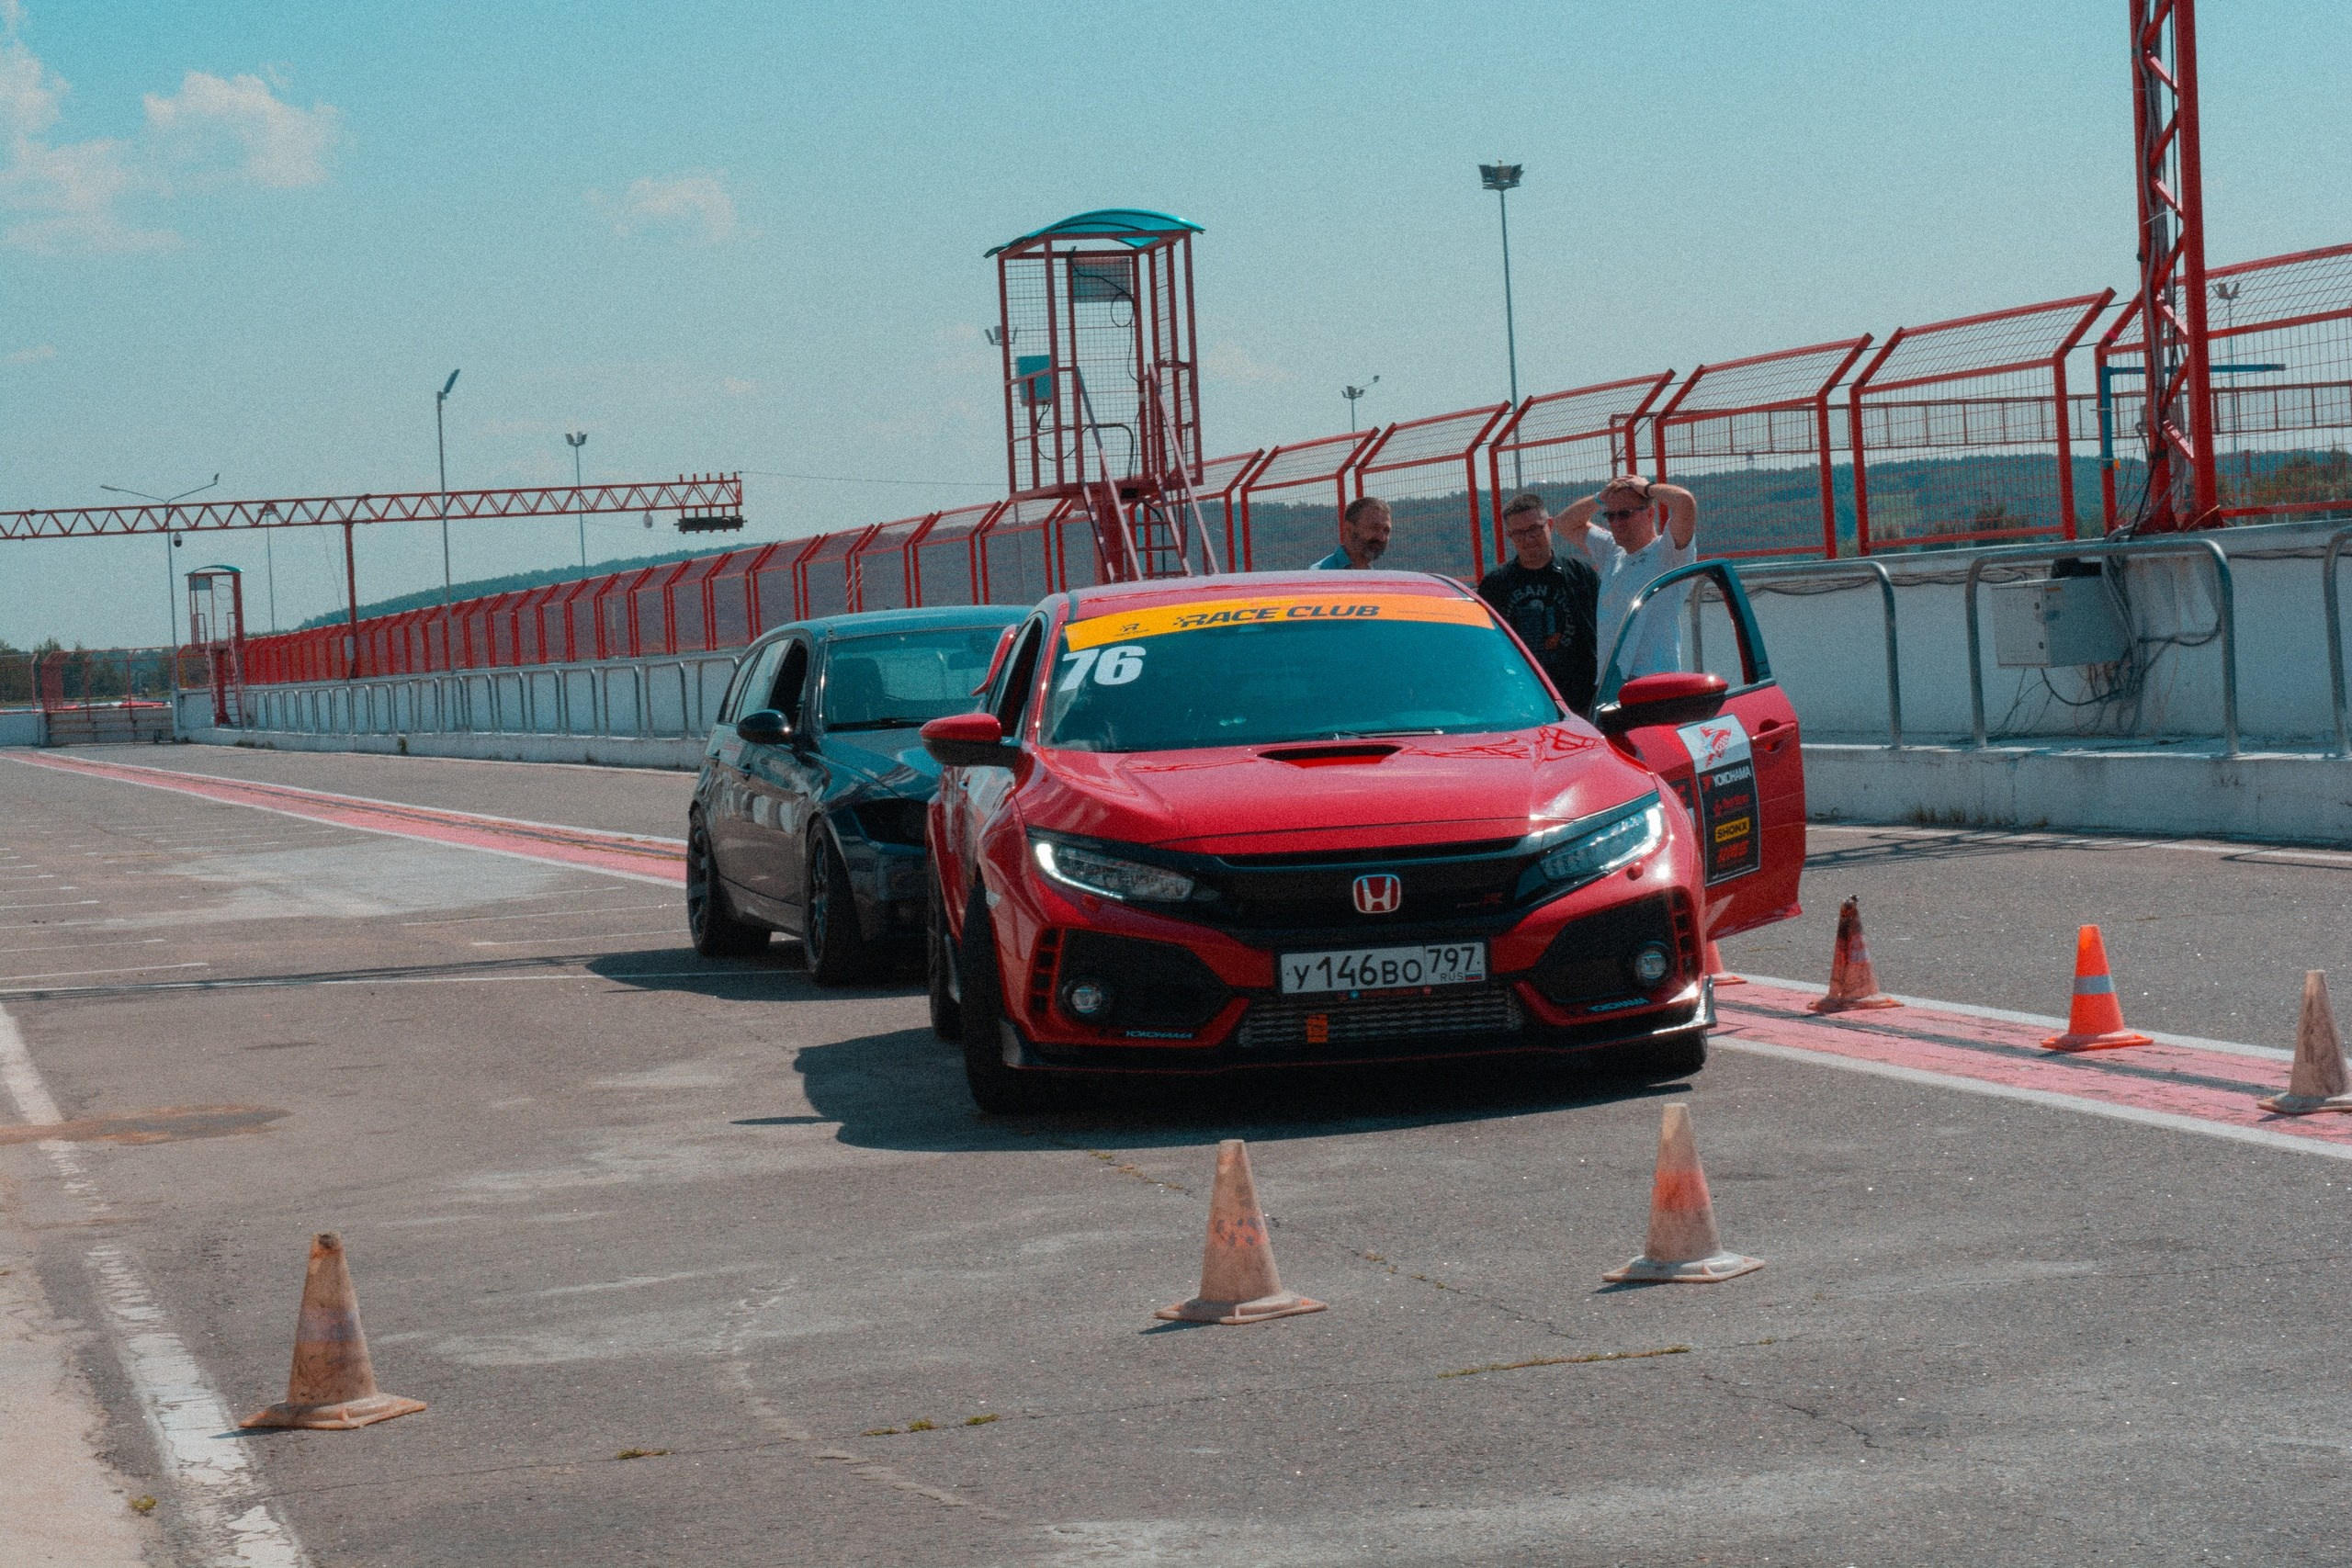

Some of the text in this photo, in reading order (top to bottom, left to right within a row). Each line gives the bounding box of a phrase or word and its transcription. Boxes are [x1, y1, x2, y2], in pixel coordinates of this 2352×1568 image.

[1176, 605, 1280, 628] RACE
[1287, 604, 1381, 617] CLUB
[1058, 646, 1147, 692] 76
[1713, 765, 1752, 787] YOKOHAMA
[1427, 946, 1476, 974] 797
[1440, 971, 1464, 982] RUS
